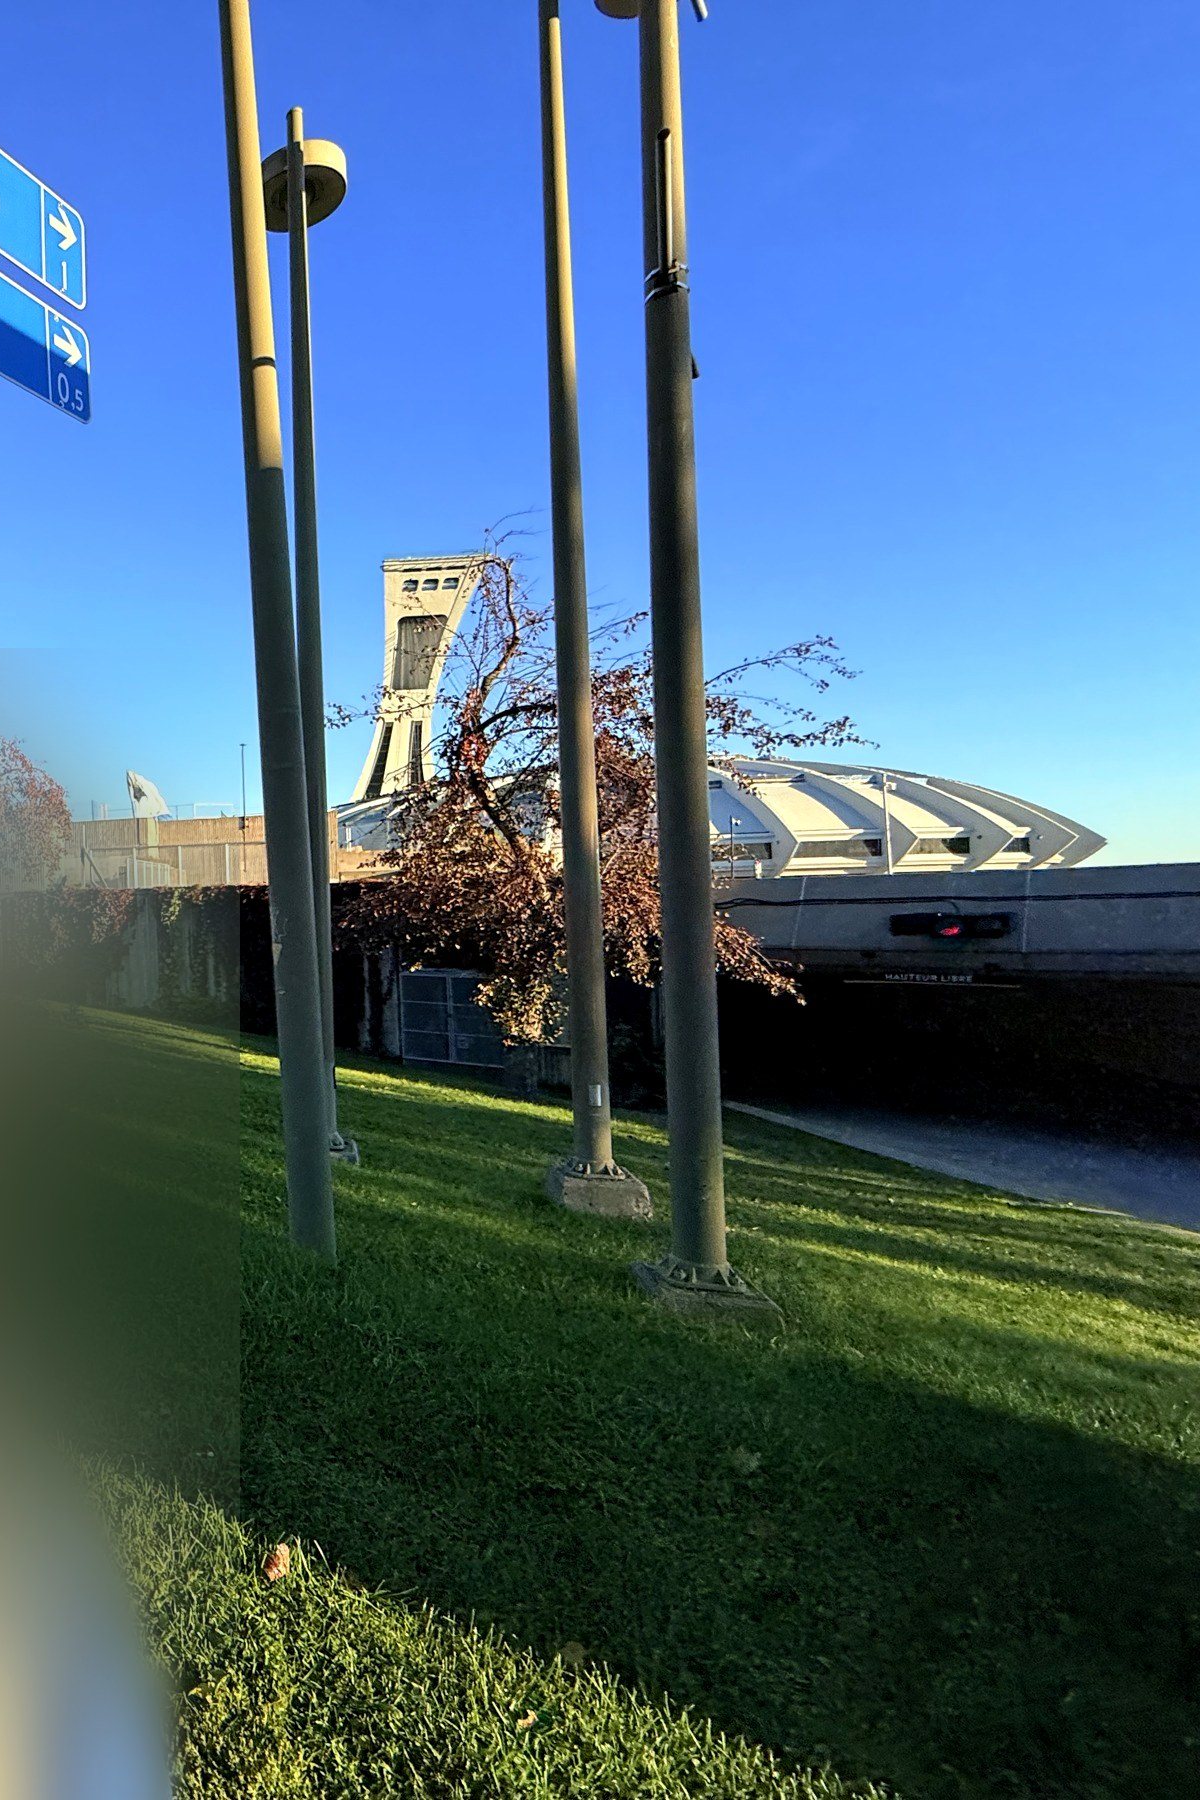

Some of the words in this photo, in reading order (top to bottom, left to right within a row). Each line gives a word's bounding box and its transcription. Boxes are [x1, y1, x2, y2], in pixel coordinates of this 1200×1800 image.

[60, 261, 69, 292] 1
[885, 973, 938, 982] HAUTEUR
[940, 974, 973, 983] LIBRE
